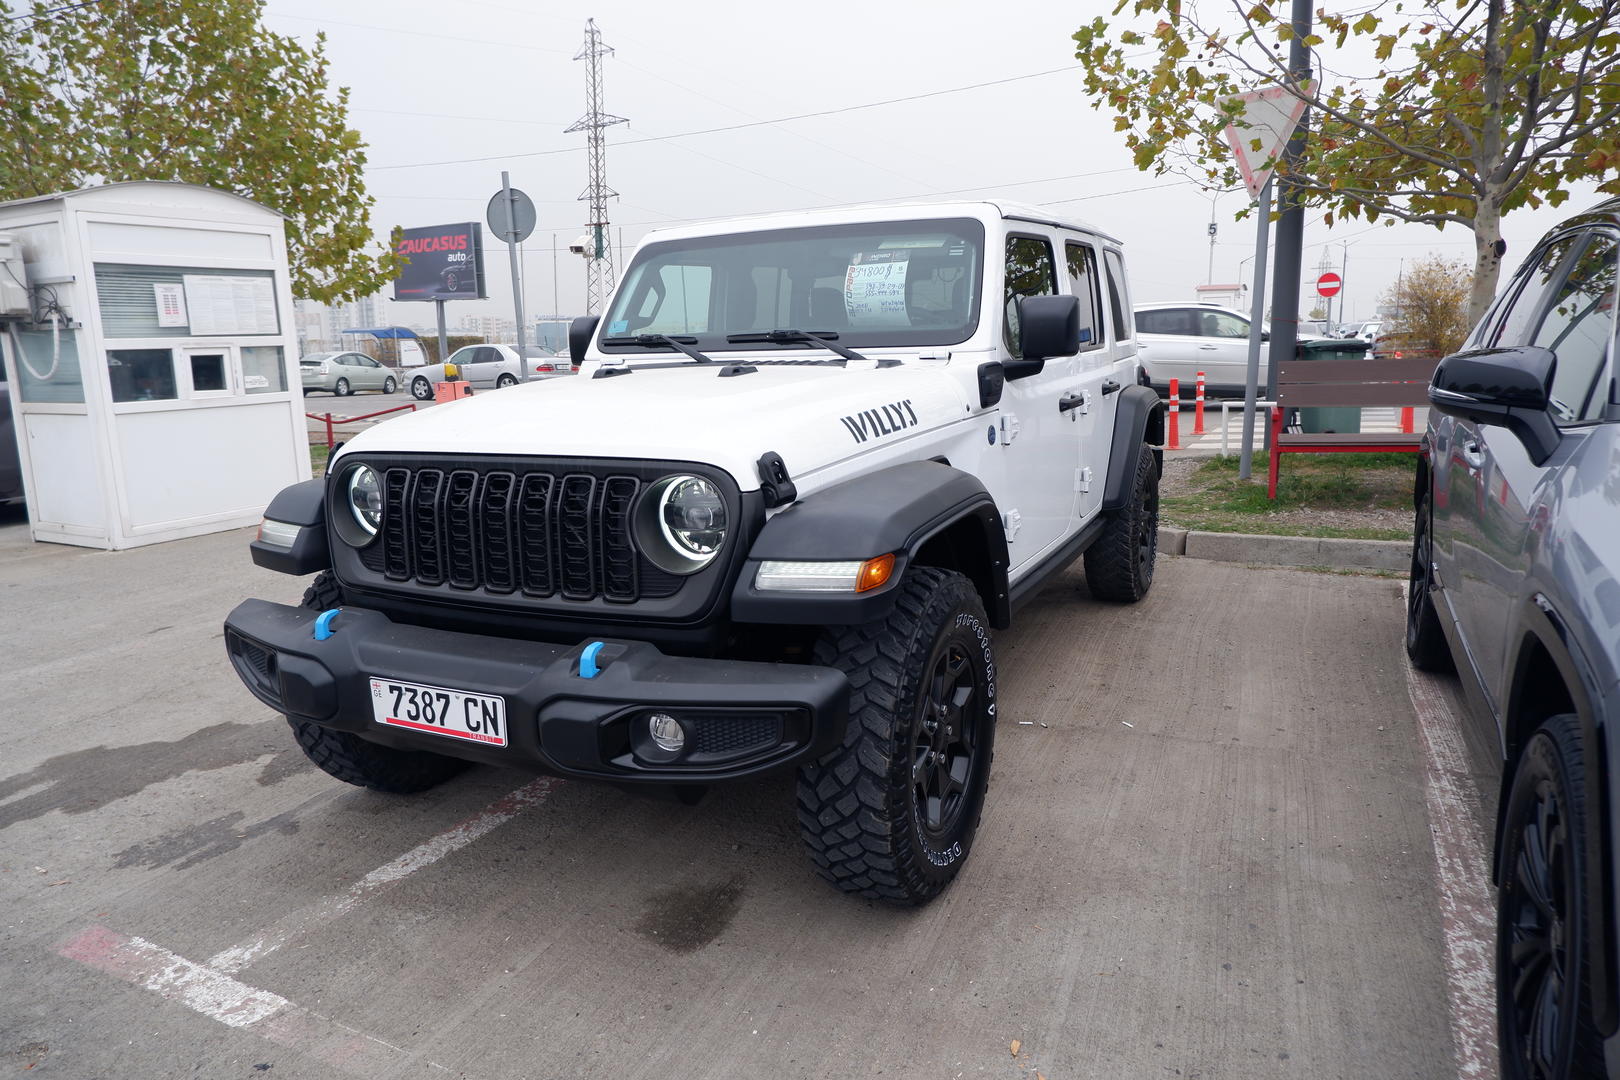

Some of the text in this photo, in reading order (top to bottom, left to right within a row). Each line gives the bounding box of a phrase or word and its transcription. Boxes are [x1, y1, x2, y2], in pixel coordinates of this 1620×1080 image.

[1209, 223, 1217, 235] 5
[398, 234, 468, 255] CAUCASUS
[447, 251, 466, 262] auto
[840, 399, 918, 444] WILLYS
[388, 684, 499, 736] 7387 CN
